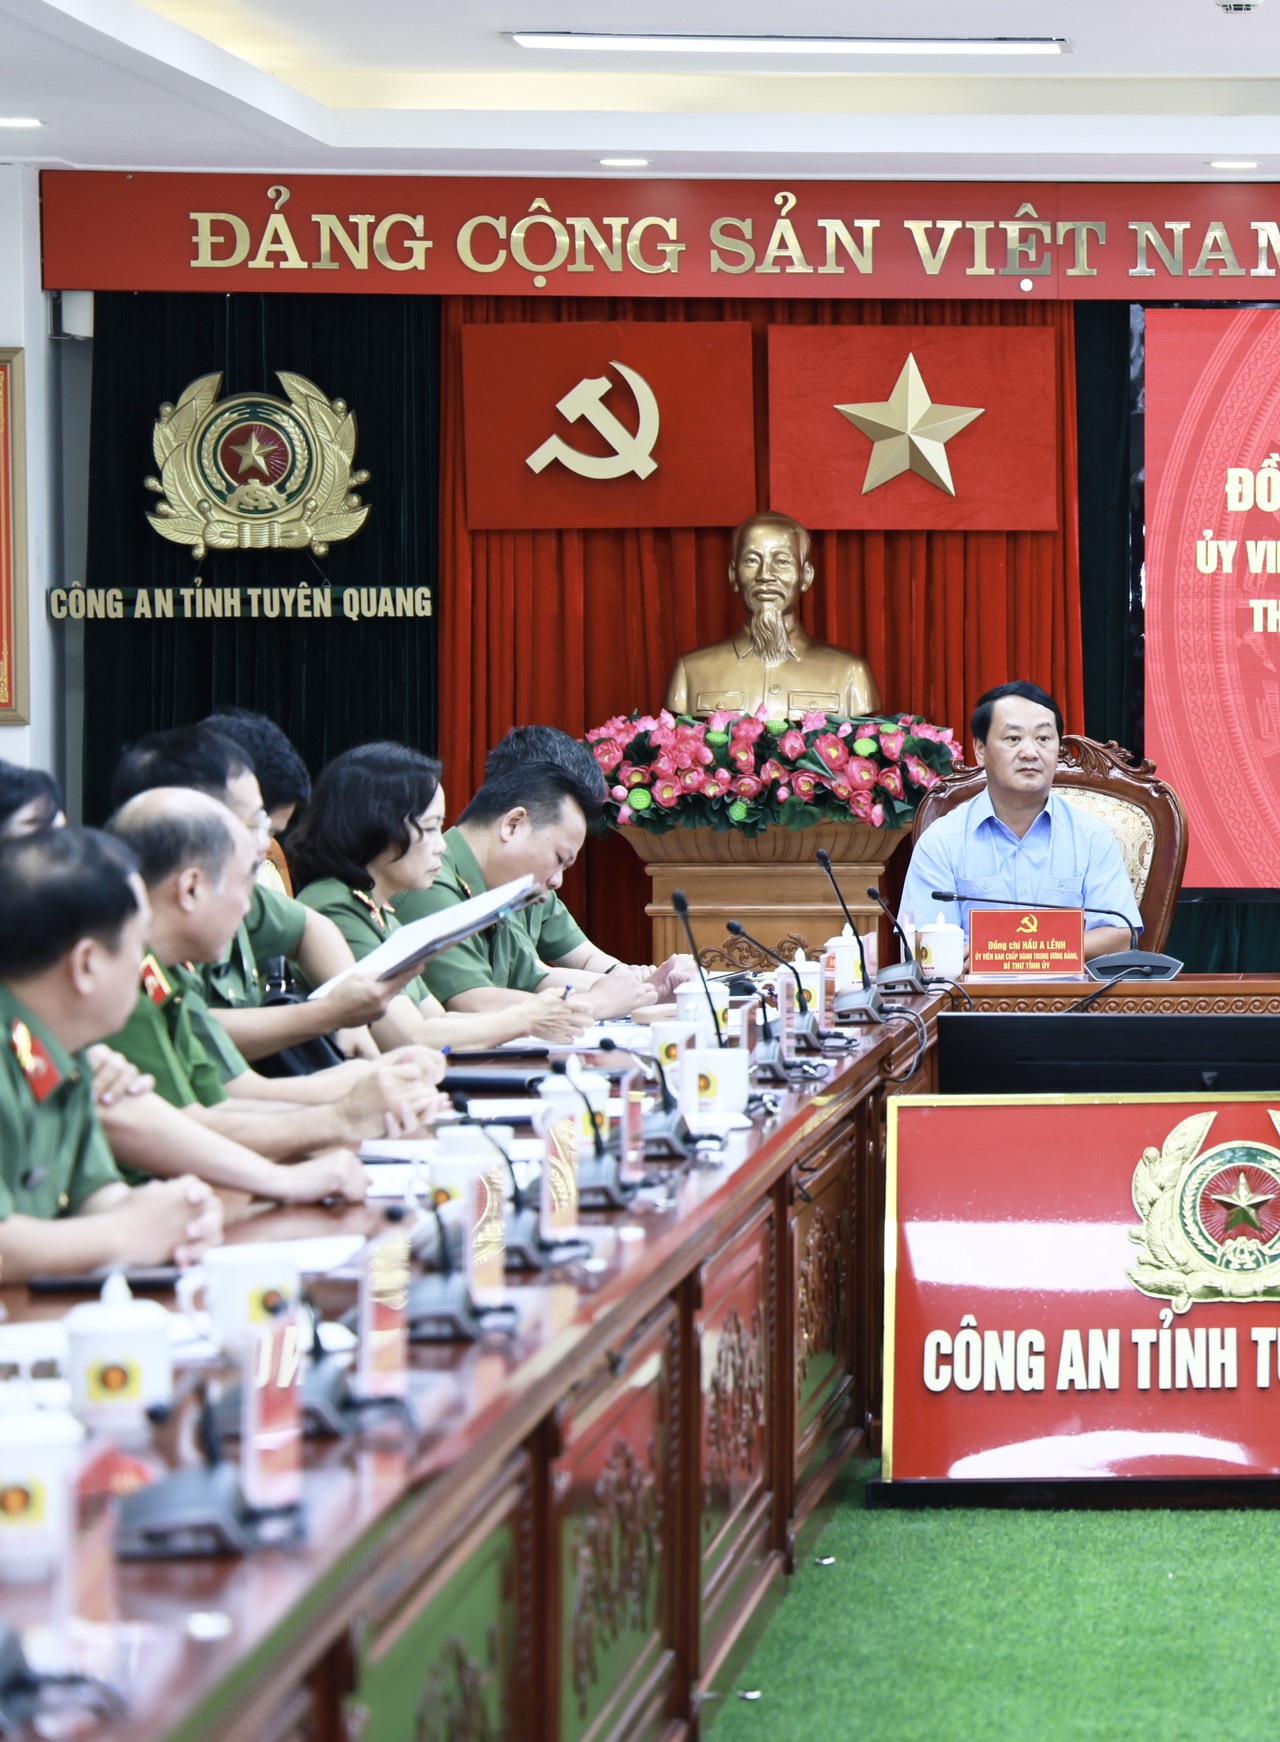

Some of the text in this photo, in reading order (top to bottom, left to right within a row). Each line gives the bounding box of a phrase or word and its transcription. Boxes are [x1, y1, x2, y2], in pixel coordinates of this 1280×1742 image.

[190, 185, 433, 271] ĐẢNG
[457, 197, 686, 288] CỘNG
[710, 191, 880, 274] SẢN
[904, 202, 1106, 292] VIỆT
[1196, 529, 1238, 574] ỦY
[50, 577, 432, 621] CÔNG AN TỈNH TUYÊN QUANG
[1040, 941, 1045, 950] A
[923, 1315, 1045, 1392] CÔNG
[1056, 1328, 1120, 1390] AN
[1132, 1308, 1237, 1389] TỈNH
